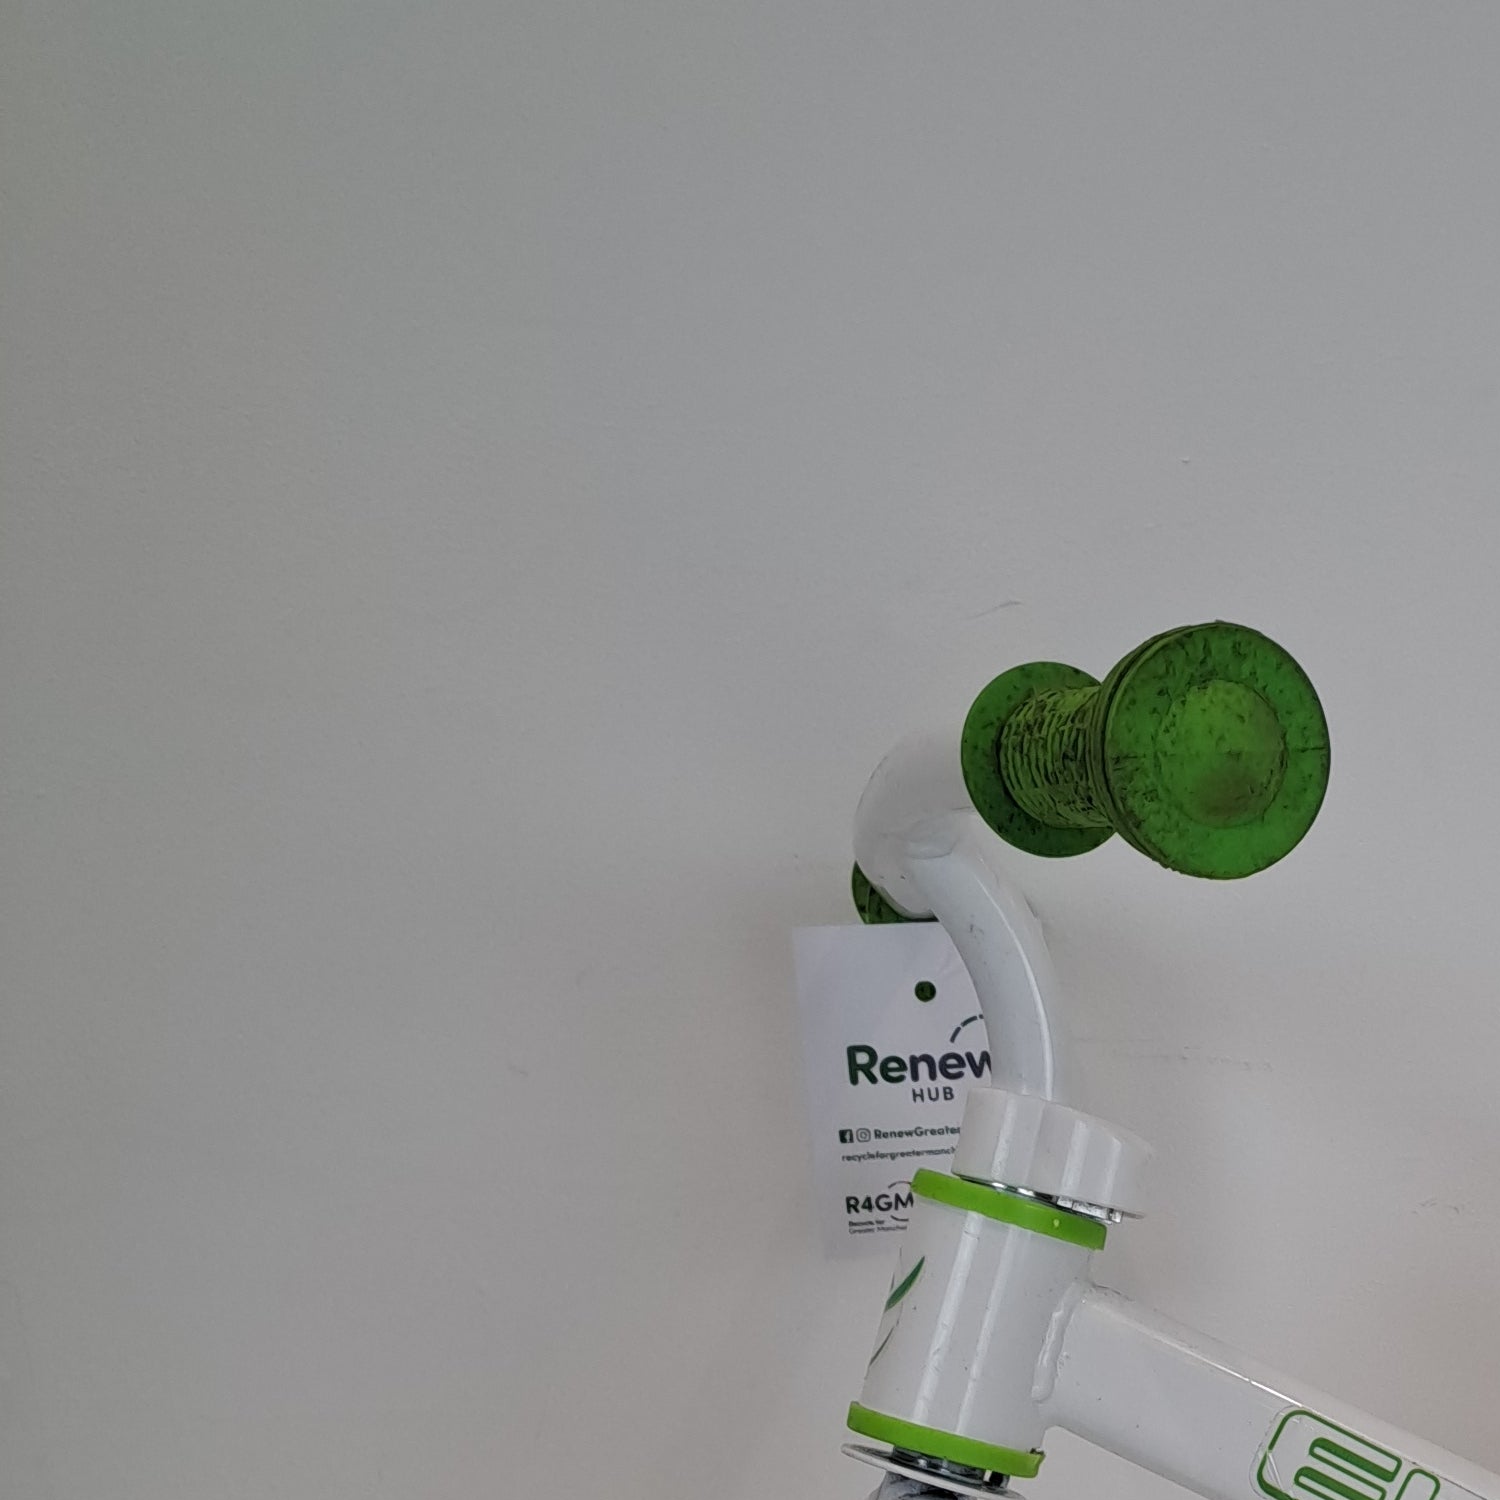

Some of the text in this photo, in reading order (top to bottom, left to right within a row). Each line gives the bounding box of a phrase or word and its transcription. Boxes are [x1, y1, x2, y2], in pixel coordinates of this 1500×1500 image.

[846, 1044, 992, 1086] Renew
[911, 1086, 955, 1103] HUB
[845, 1191, 915, 1214] R4GM
